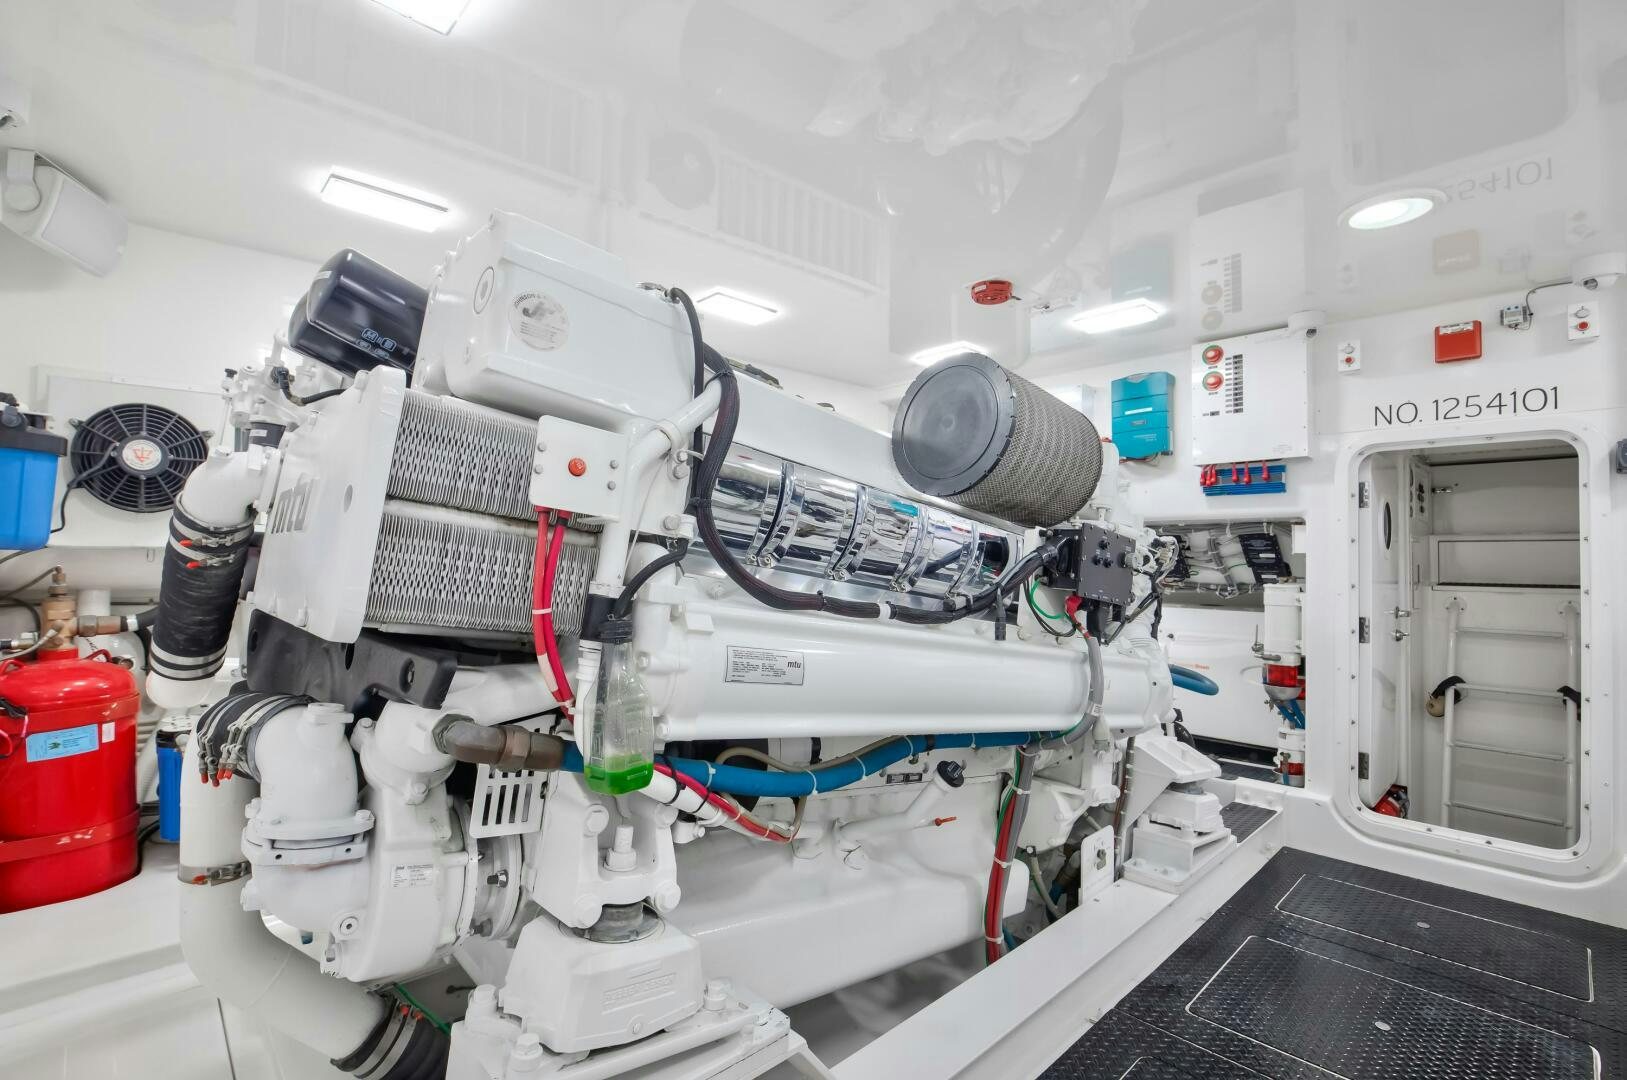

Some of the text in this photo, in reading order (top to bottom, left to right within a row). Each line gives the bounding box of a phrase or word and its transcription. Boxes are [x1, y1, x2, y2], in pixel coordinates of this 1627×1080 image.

[1374, 386, 1558, 426] NO. 1254101
[787, 660, 802, 669] mtu
